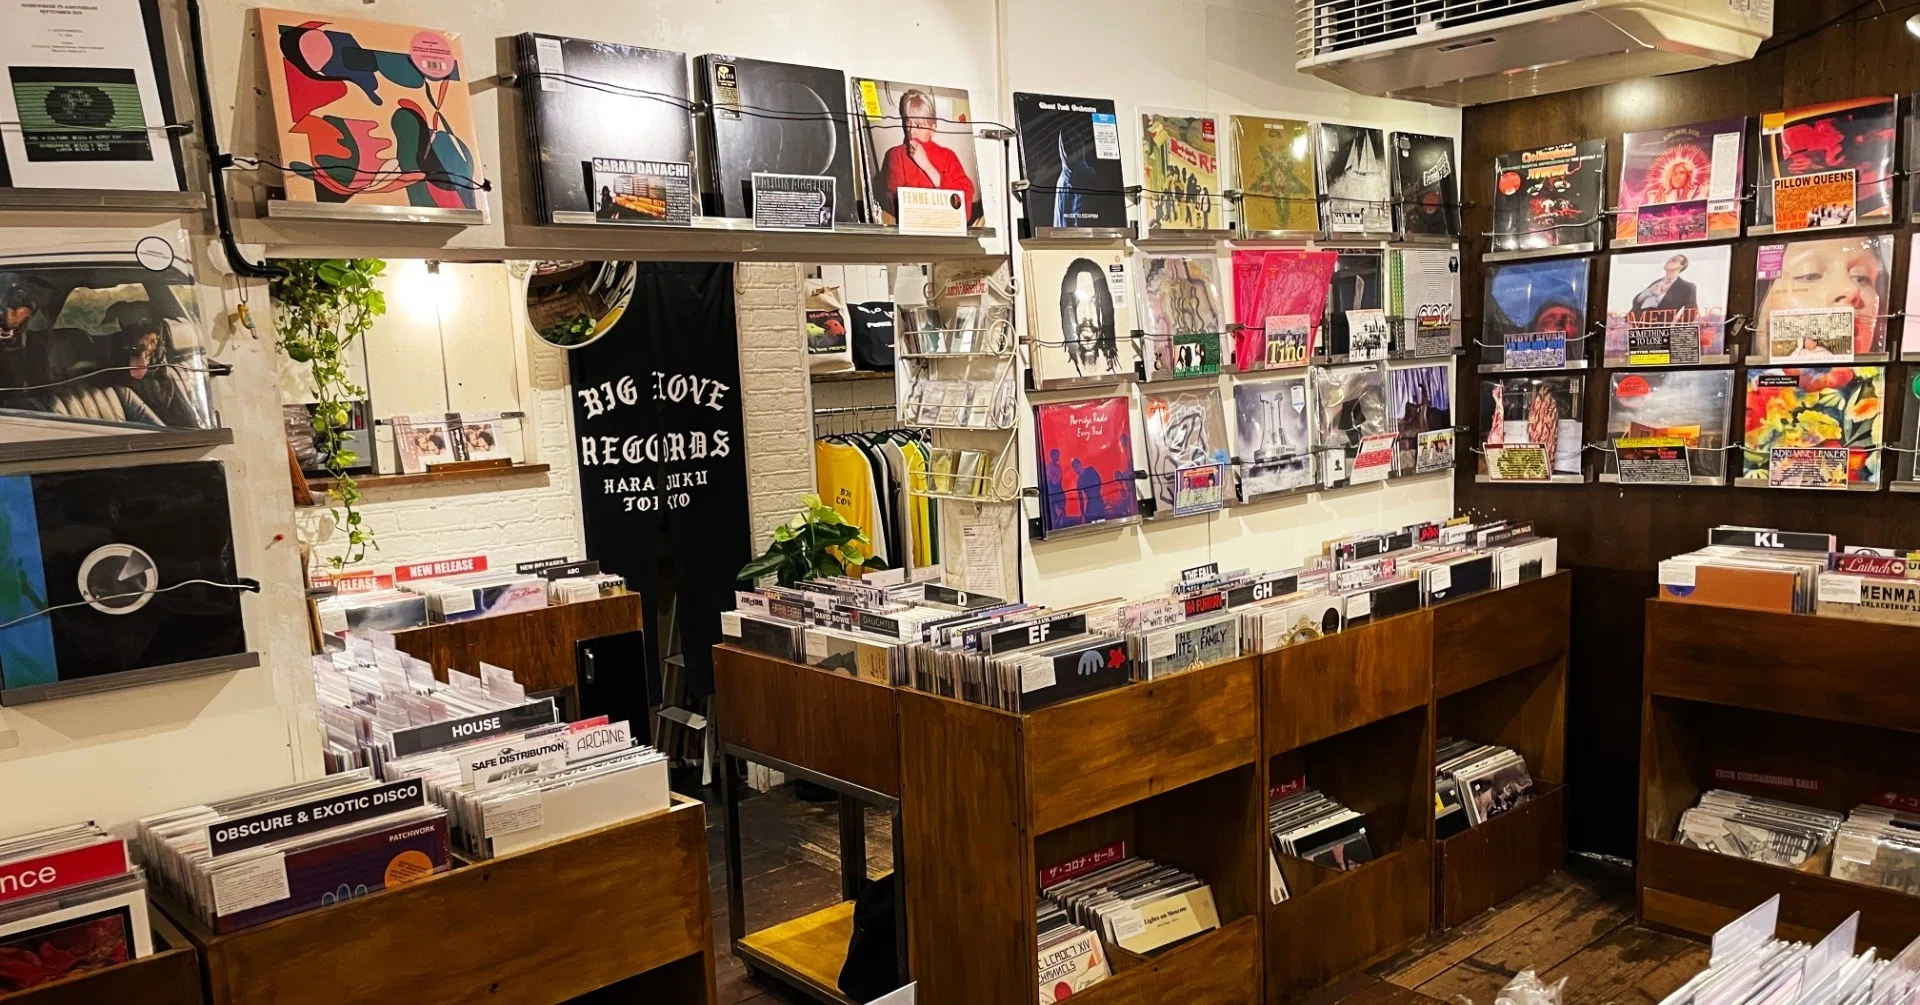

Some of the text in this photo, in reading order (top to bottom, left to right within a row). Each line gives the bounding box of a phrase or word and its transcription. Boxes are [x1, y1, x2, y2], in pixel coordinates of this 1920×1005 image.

[594, 158, 689, 177] SARAH DAVACHI
[1774, 171, 1854, 190] PILLOW QUEENS
[903, 191, 949, 206] FENNE LILY
[1629, 329, 1669, 339] SOMETHING
[1636, 337, 1662, 346] TO LOSE
[578, 375, 638, 420] BIG
[1069, 411, 1108, 426] Porridge Radio
[1092, 426, 1103, 436] Bad
[1773, 449, 1846, 459] ADRIANNE LENKER
[1379, 538, 1389, 553] IJ
[1755, 532, 1784, 548] KL
[410, 559, 475, 578] NEW RELEASE
[1846, 557, 1891, 574] Laibach
[1184, 569, 1199, 580] THE
[957, 591, 968, 606] D
[1252, 582, 1273, 600] GH
[815, 611, 832, 621] DAVID
[832, 614, 850, 625] BOWIE
[863, 617, 896, 630] DAUGHTER
[1028, 623, 1050, 645] EF
[452, 719, 501, 738] HOUSE
[577, 731, 625, 752] ARCANE
[472, 743, 565, 771] SAFE DISTRIBUTION
[215, 785, 418, 843] OBSCURE & EXOTIC DISCO
[389, 825, 435, 843] PATCHWORK
[1167, 906, 1187, 917] Moscow
